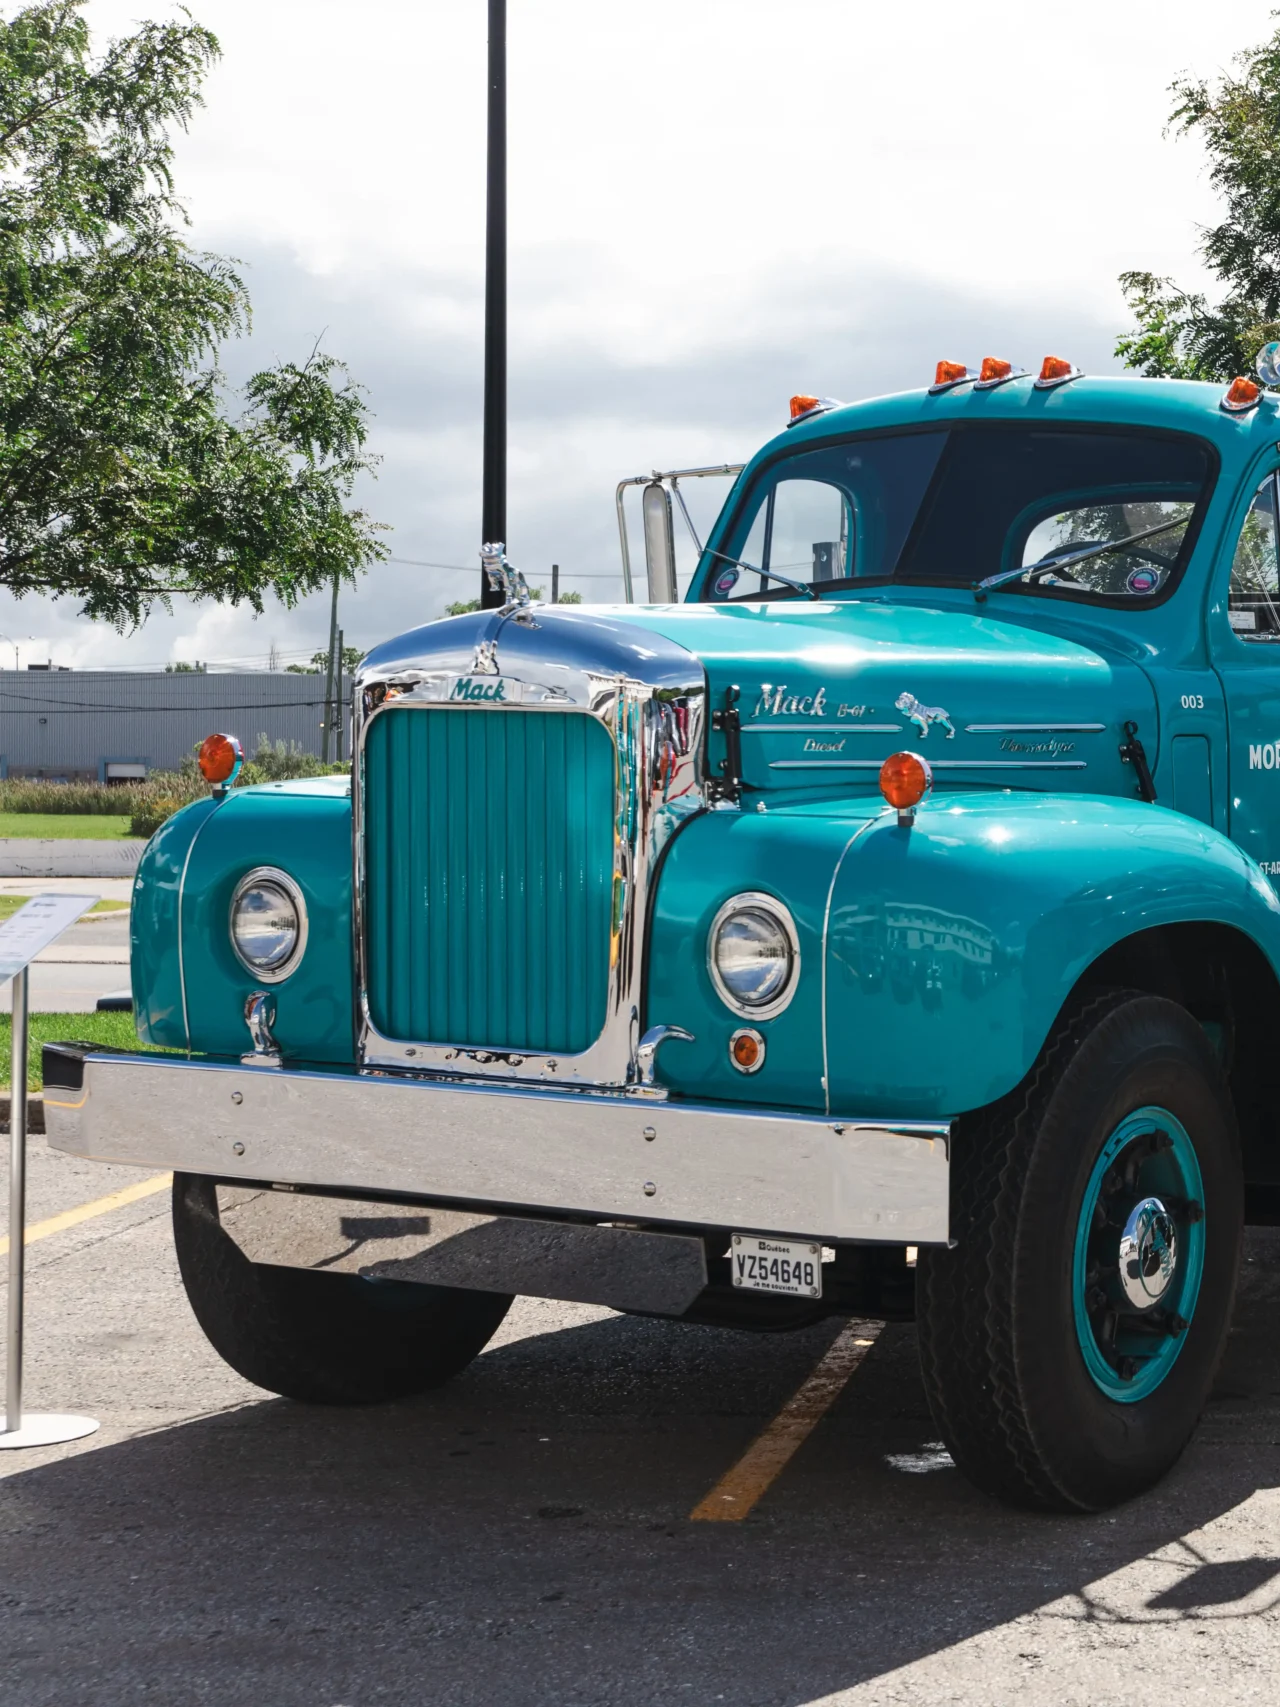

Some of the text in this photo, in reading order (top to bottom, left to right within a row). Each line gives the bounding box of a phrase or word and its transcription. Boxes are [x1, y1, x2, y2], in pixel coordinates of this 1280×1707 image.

[450, 678, 507, 702] Mack
[751, 683, 827, 718] Mack
[1181, 695, 1204, 709] 003
[803, 738, 846, 752] Diesel
[737, 1253, 814, 1287] VZ54648
